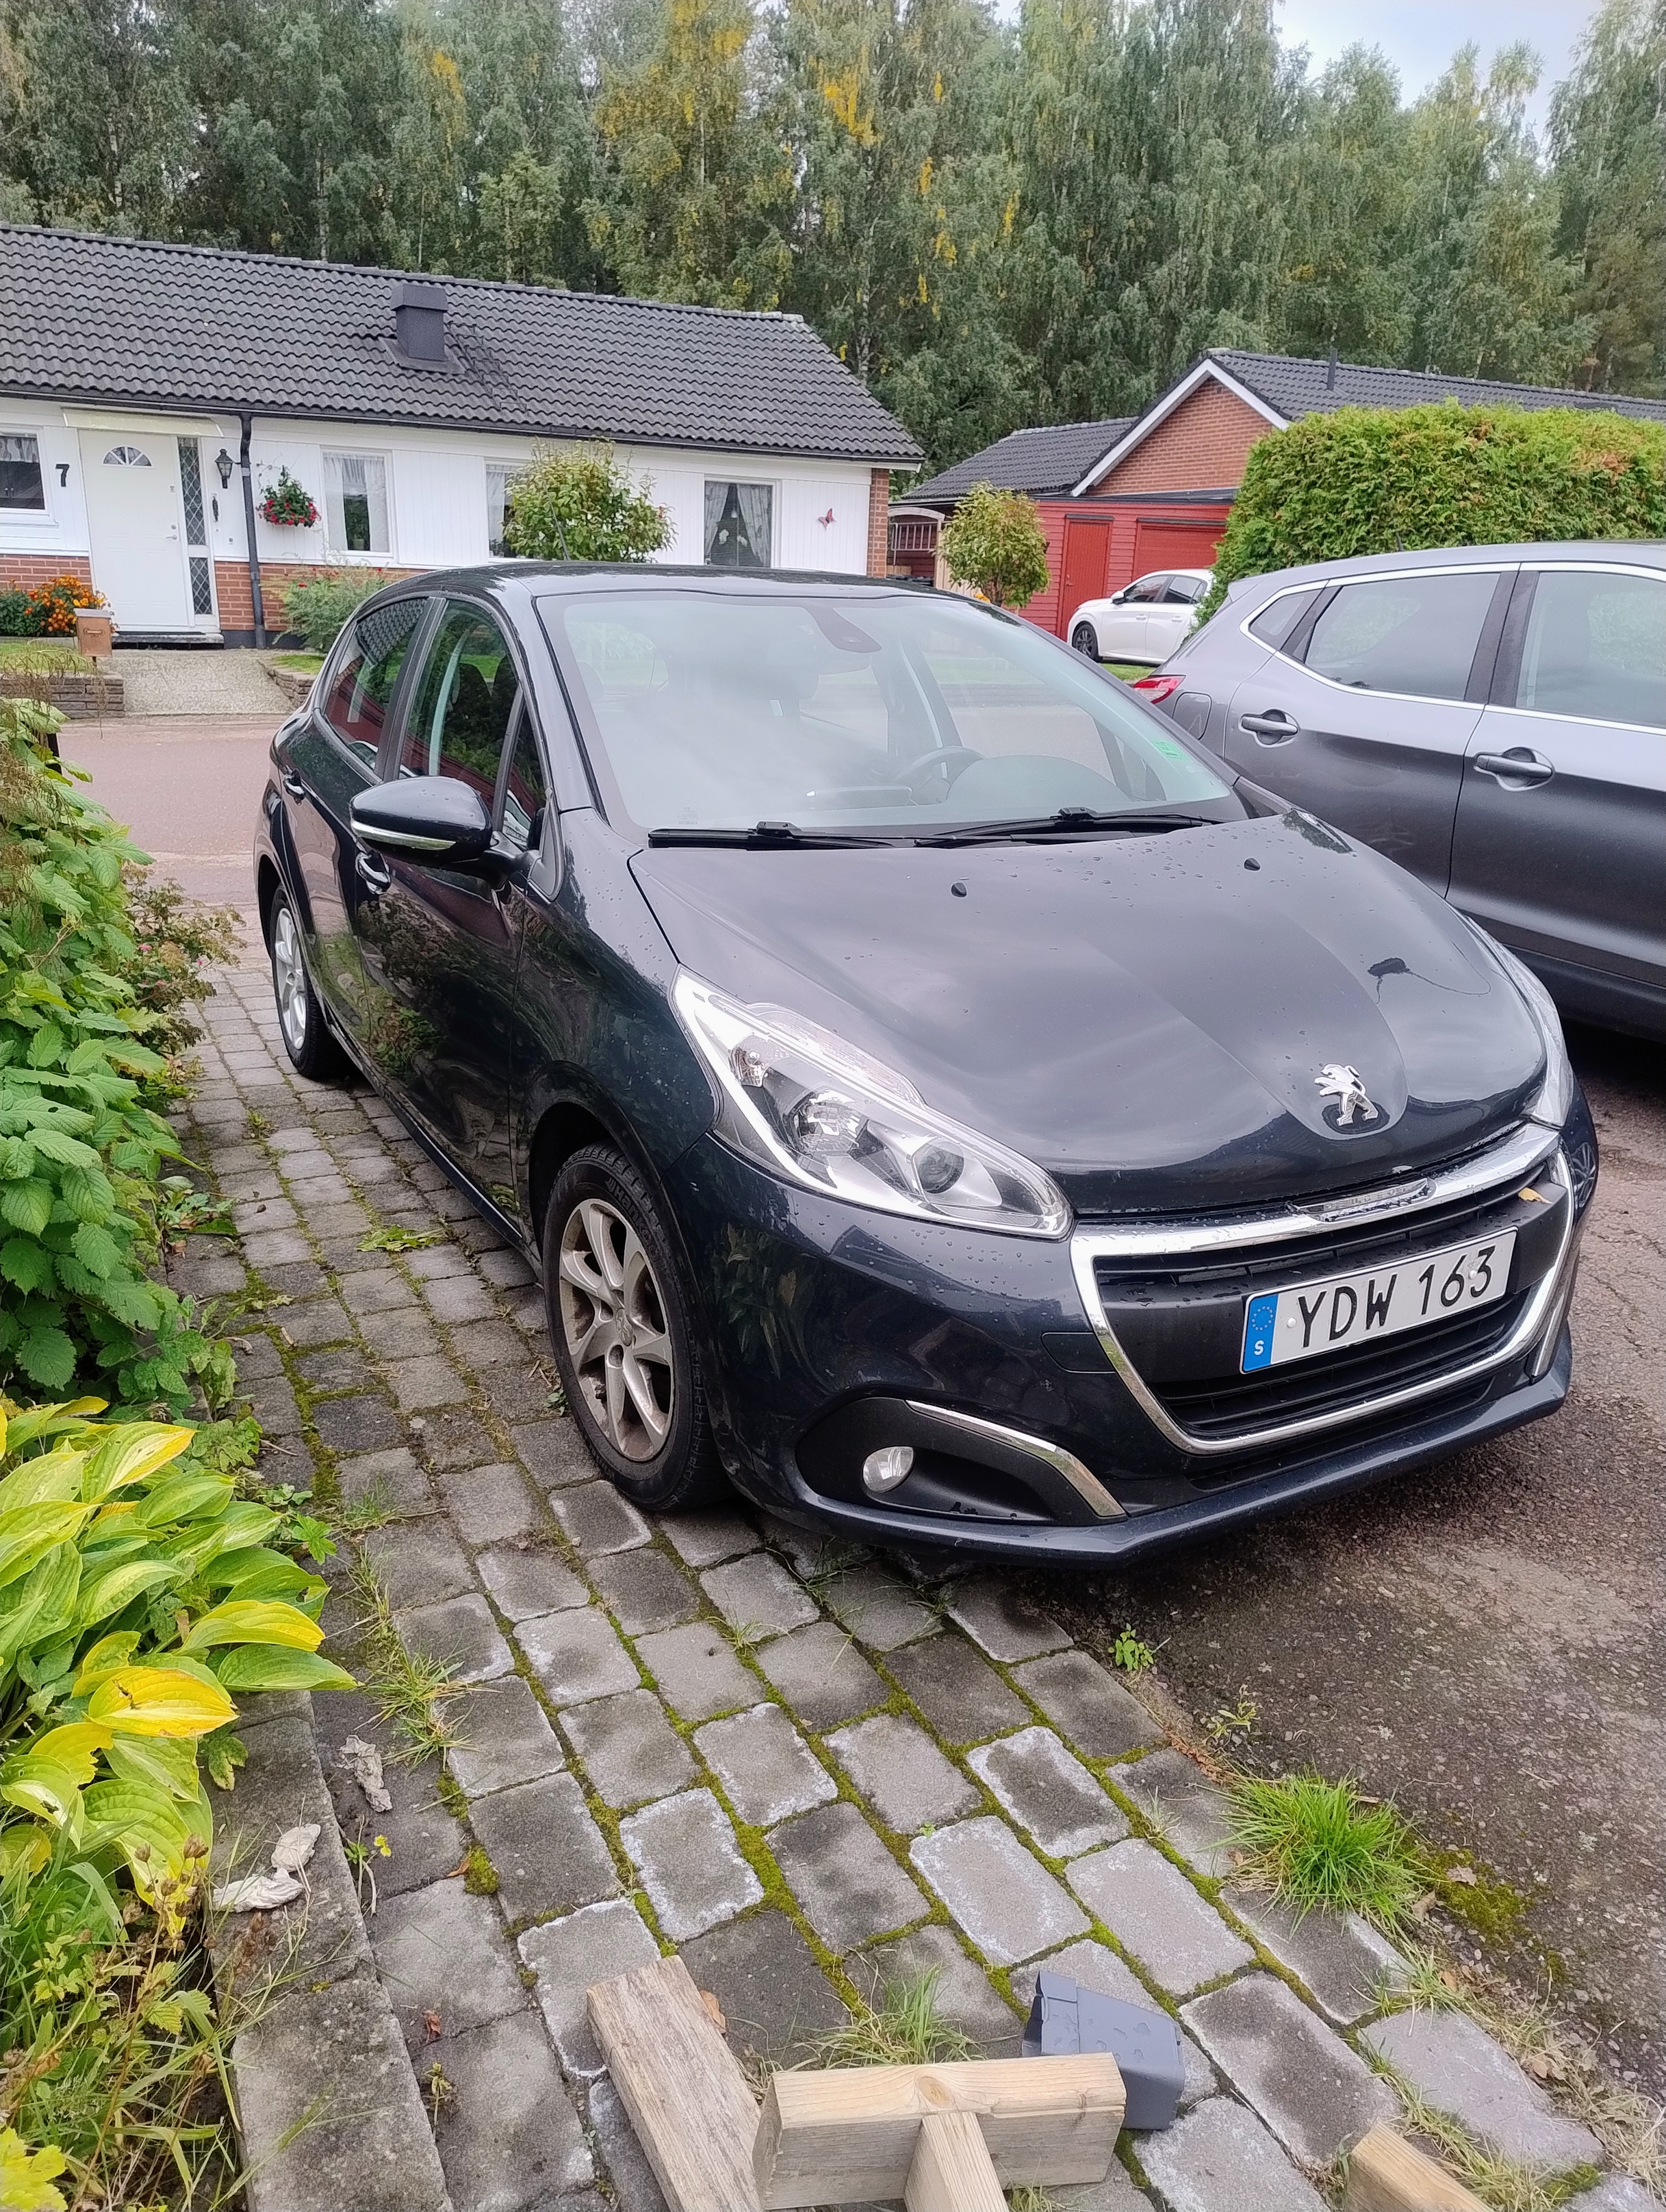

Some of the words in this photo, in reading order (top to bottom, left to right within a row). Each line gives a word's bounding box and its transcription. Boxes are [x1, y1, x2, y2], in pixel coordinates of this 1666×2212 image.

[55, 464, 69, 487] 7
[1298, 1274, 1398, 1348] YDW
[1419, 1245, 1495, 1315] 163
[1254, 1340, 1264, 1355] S
